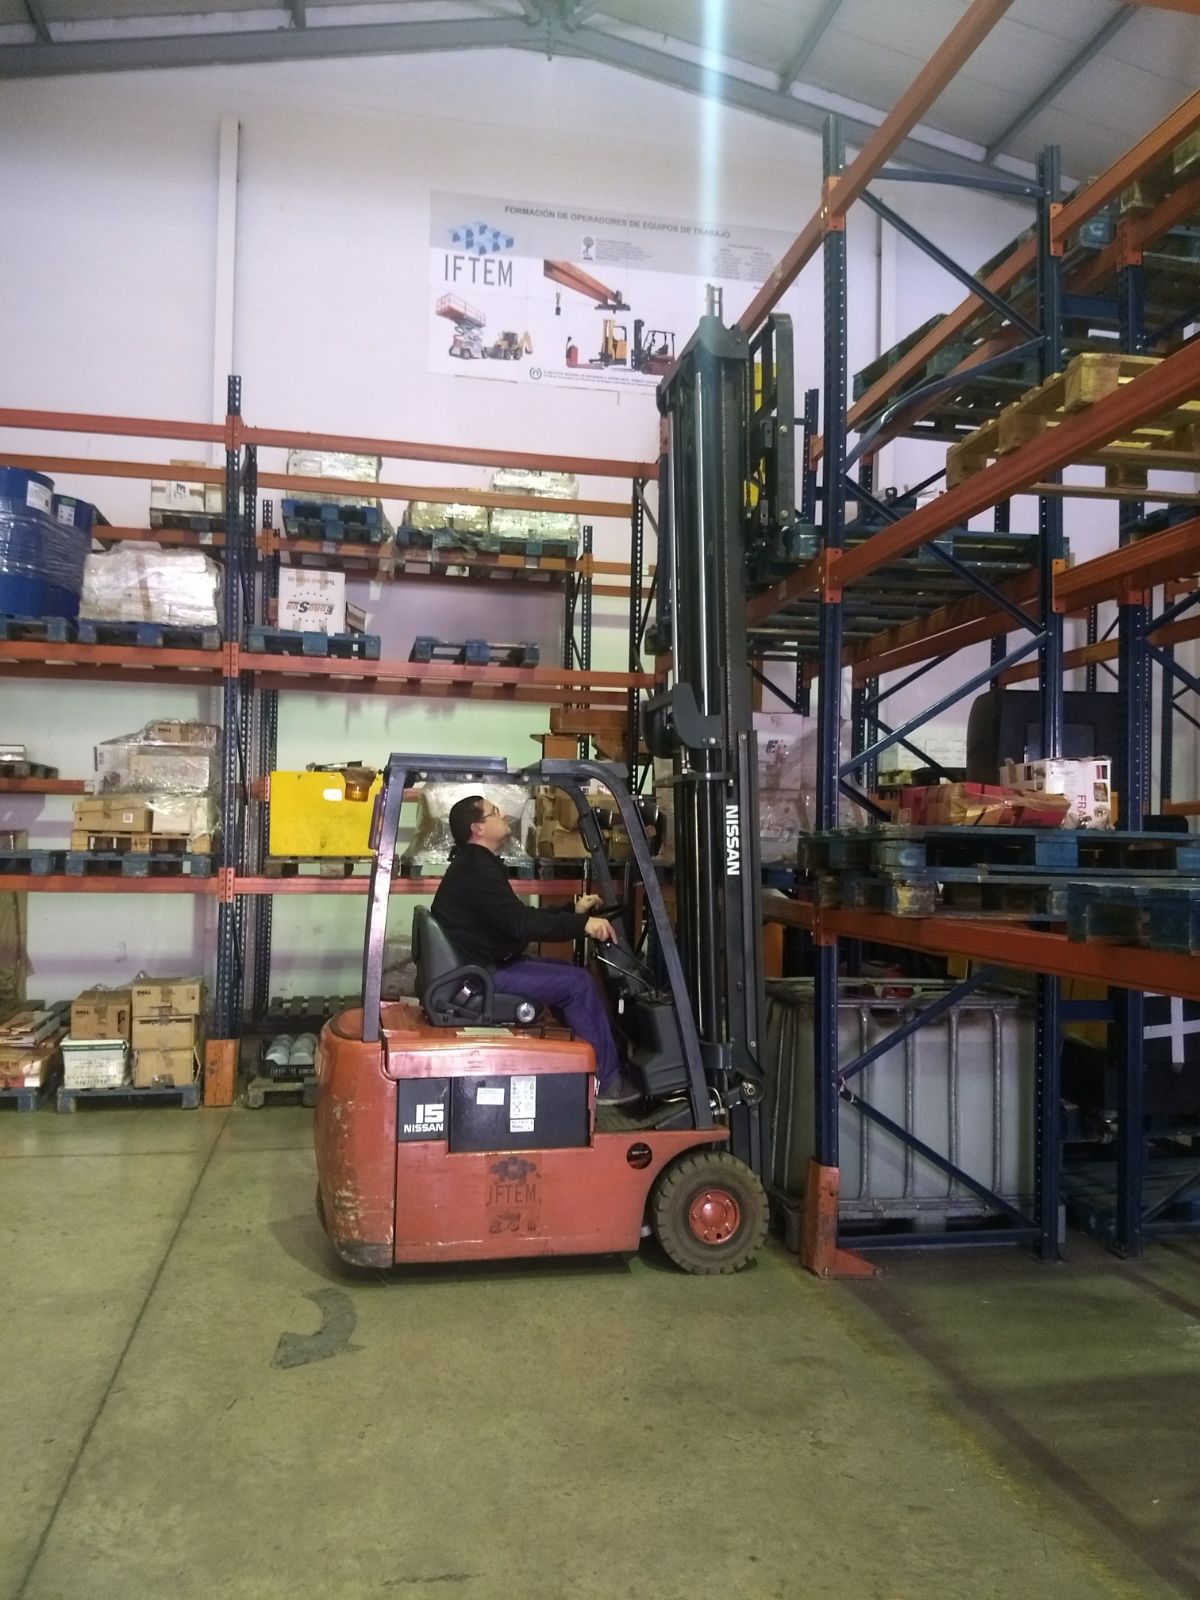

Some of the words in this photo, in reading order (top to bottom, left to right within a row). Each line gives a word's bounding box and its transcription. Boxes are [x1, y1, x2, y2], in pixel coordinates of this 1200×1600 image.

[505, 205, 555, 219] FORMACIÓN
[557, 212, 568, 220] DE
[570, 212, 627, 227] OPERADORES
[629, 219, 641, 229] DE
[642, 221, 679, 233] EQUIPOS
[680, 225, 691, 234] DE
[445, 254, 513, 287] IFTEM
[725, 804, 740, 876] NISSAN
[403, 1123, 444, 1133] NISSAN
